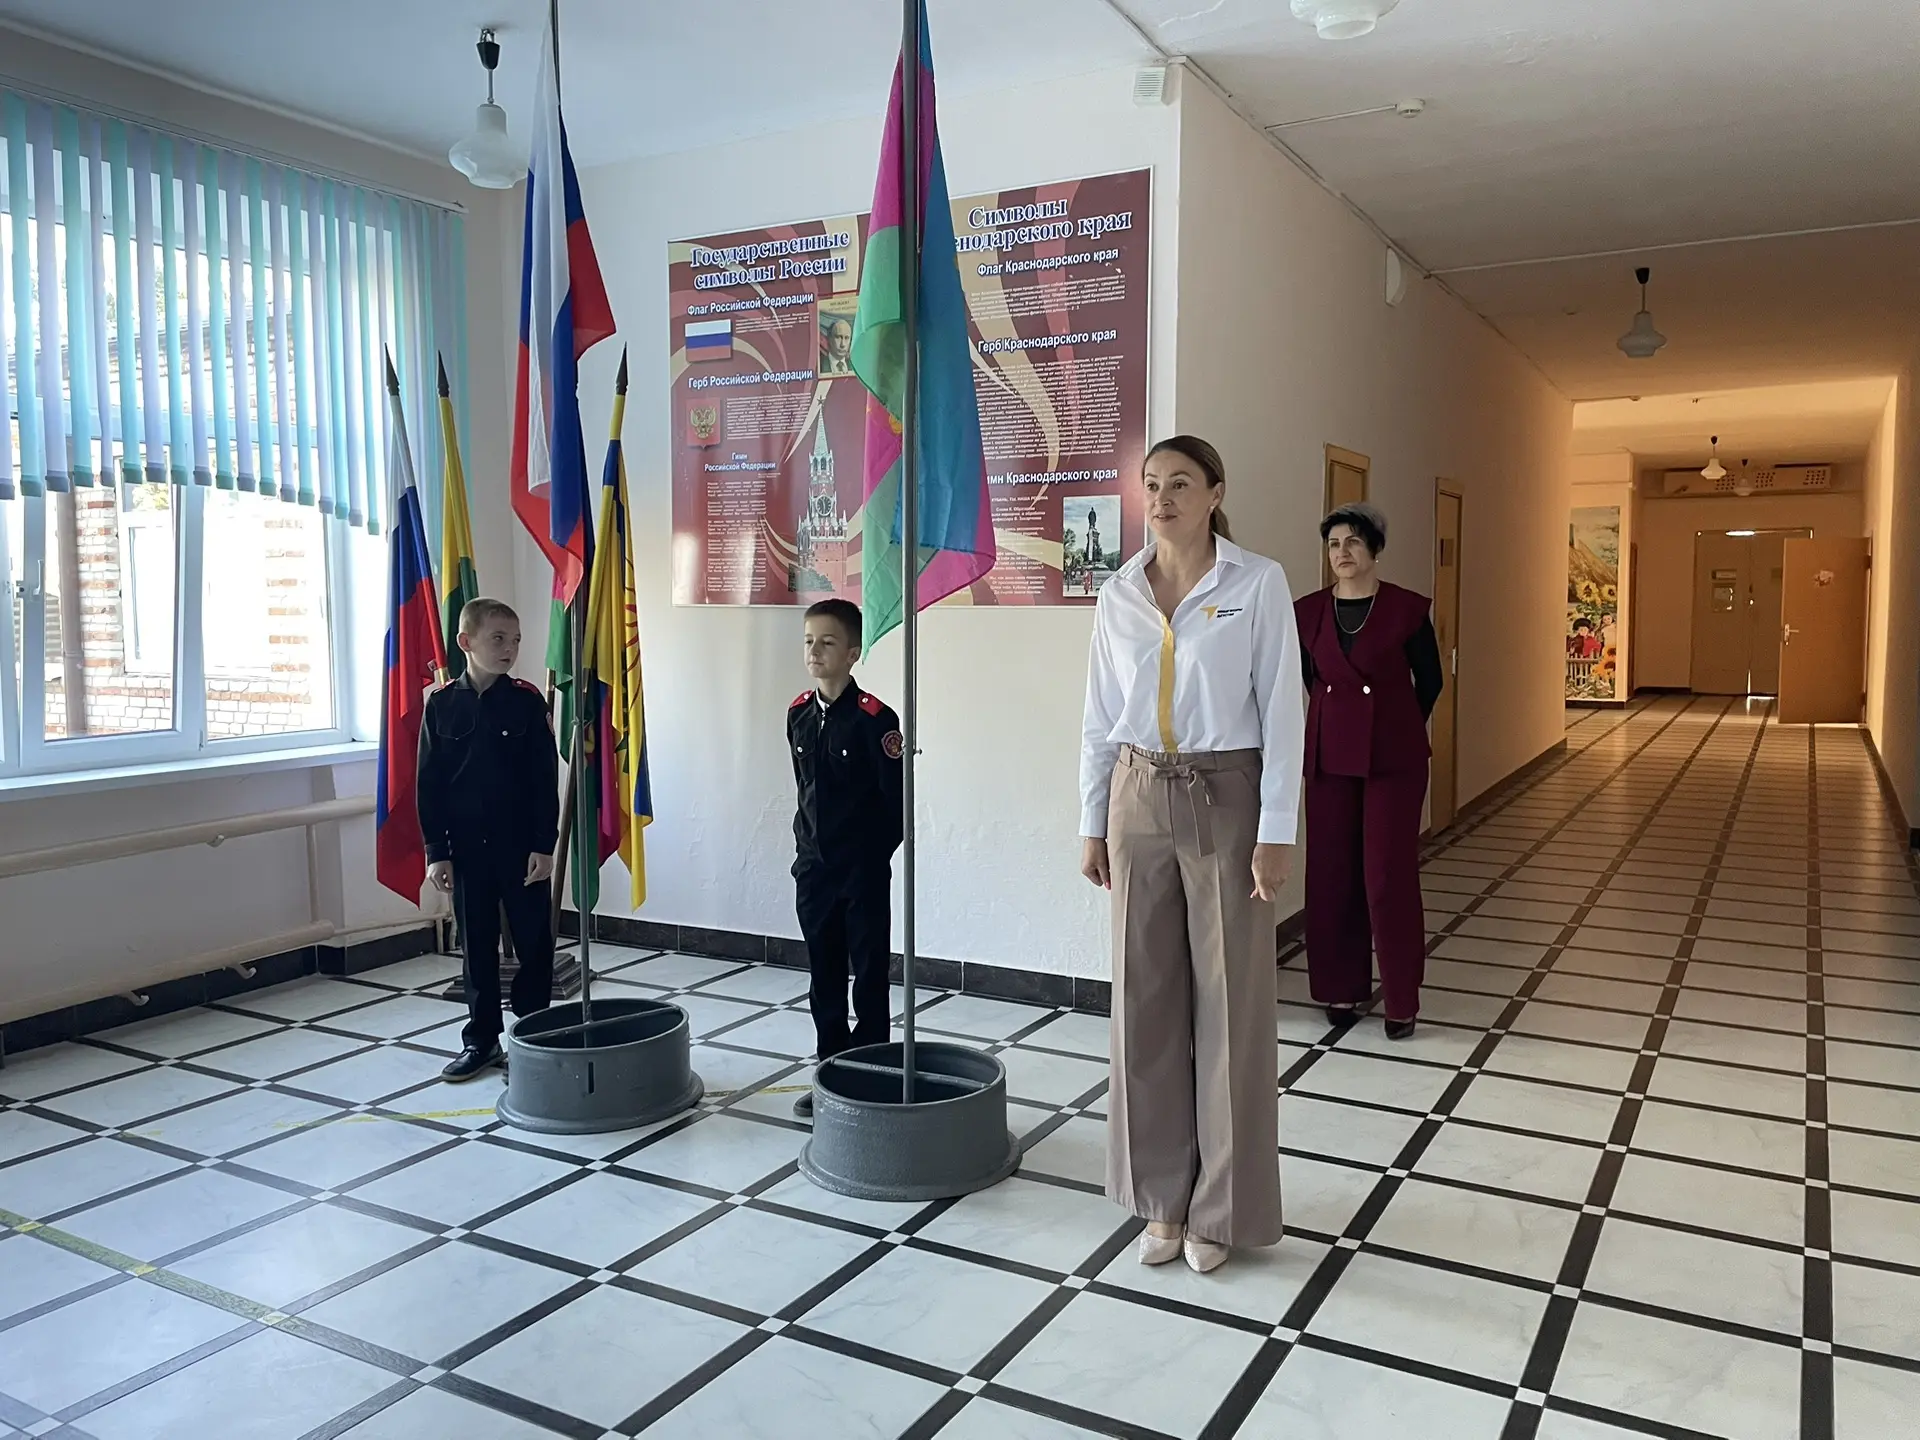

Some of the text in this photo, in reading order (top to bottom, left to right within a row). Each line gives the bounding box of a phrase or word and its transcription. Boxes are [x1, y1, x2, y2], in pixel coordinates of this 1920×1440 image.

[968, 199, 1068, 228] Символы
[955, 211, 1132, 252] нодарского края
[690, 231, 850, 268] Государственные
[694, 257, 847, 290] символы России
[977, 248, 1119, 277] Флаг Краснодарского края
[687, 304, 709, 316] Флаг
[710, 296, 761, 313] Российской
[762, 292, 814, 310] Федерации
[978, 329, 1117, 354] Герб Краснодарского края
[688, 369, 813, 390] Герб Российской Федерации
[704, 461, 776, 472] Российской Федерации
[731, 452, 748, 460] Гимн
[987, 468, 1118, 486] мн Краснодарского края
